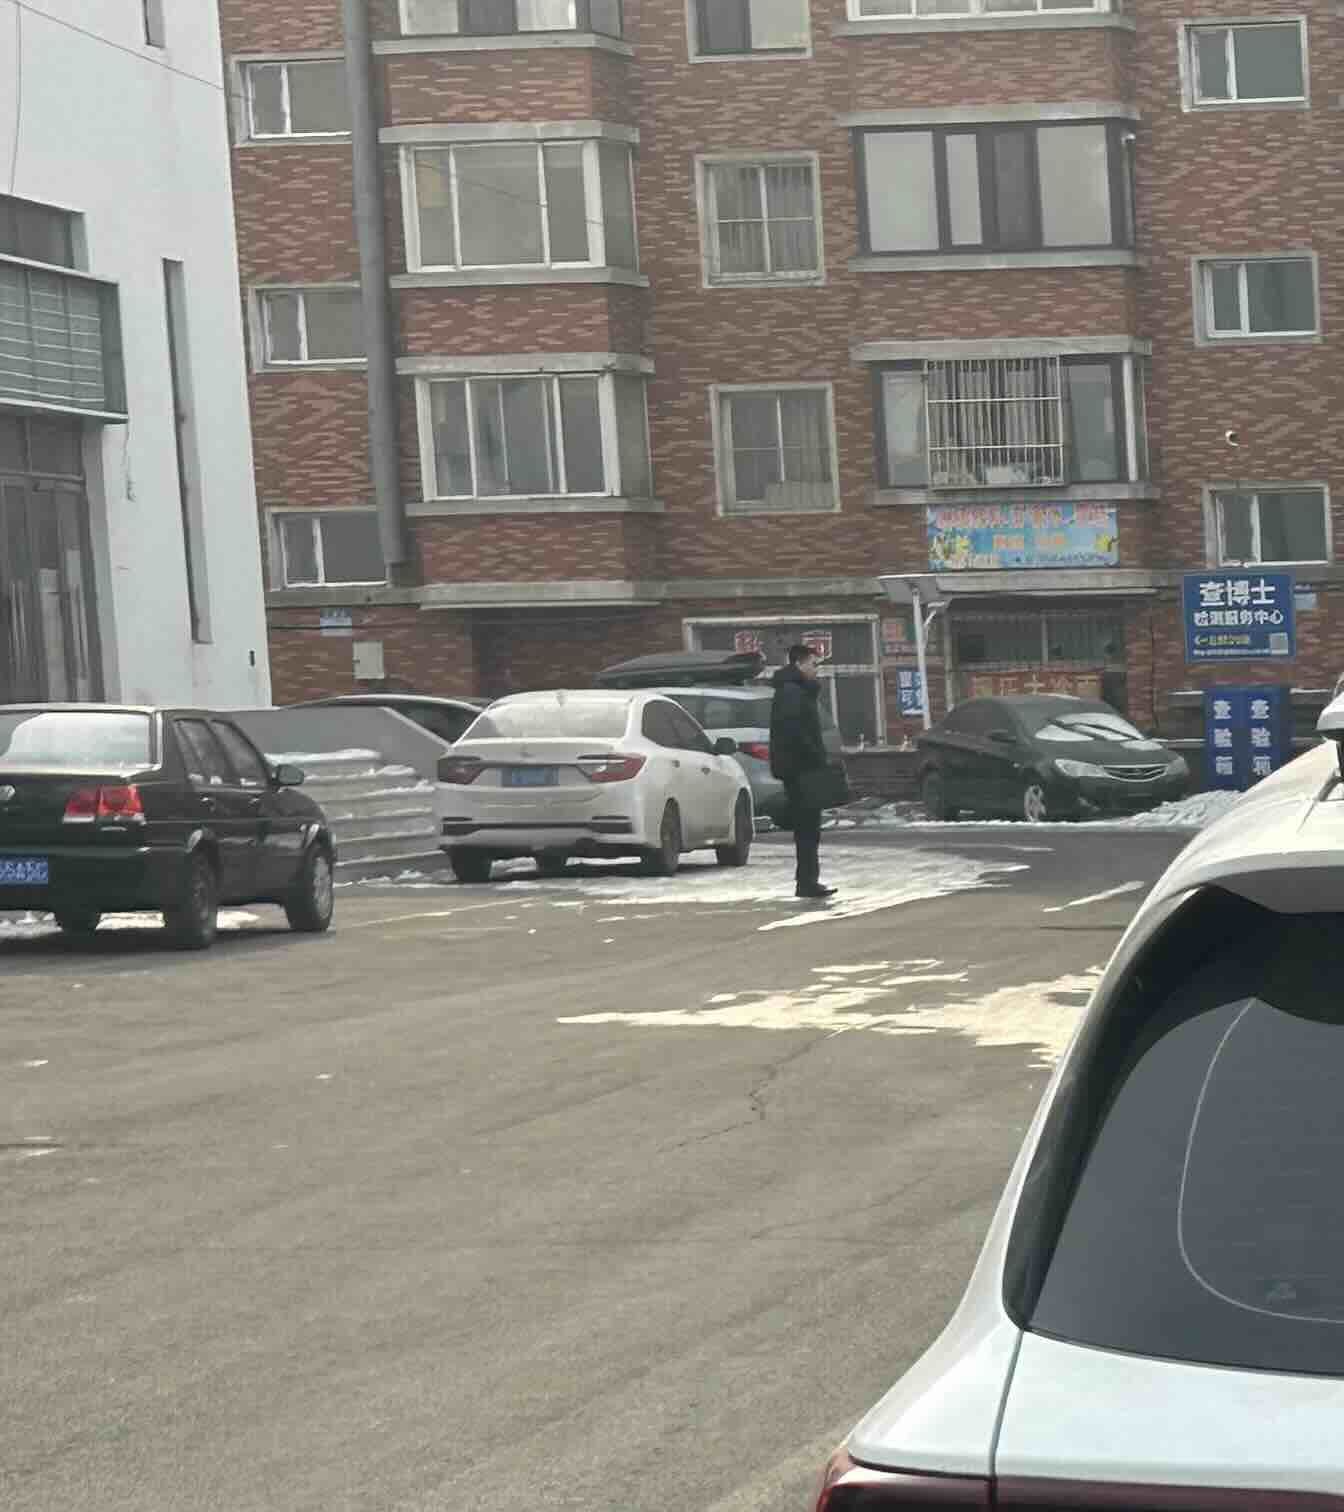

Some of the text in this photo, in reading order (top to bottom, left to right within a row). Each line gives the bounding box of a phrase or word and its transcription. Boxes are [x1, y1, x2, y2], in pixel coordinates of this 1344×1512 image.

[1199, 578, 1276, 607] 查博士
[1193, 609, 1284, 627] 检测服务中心
